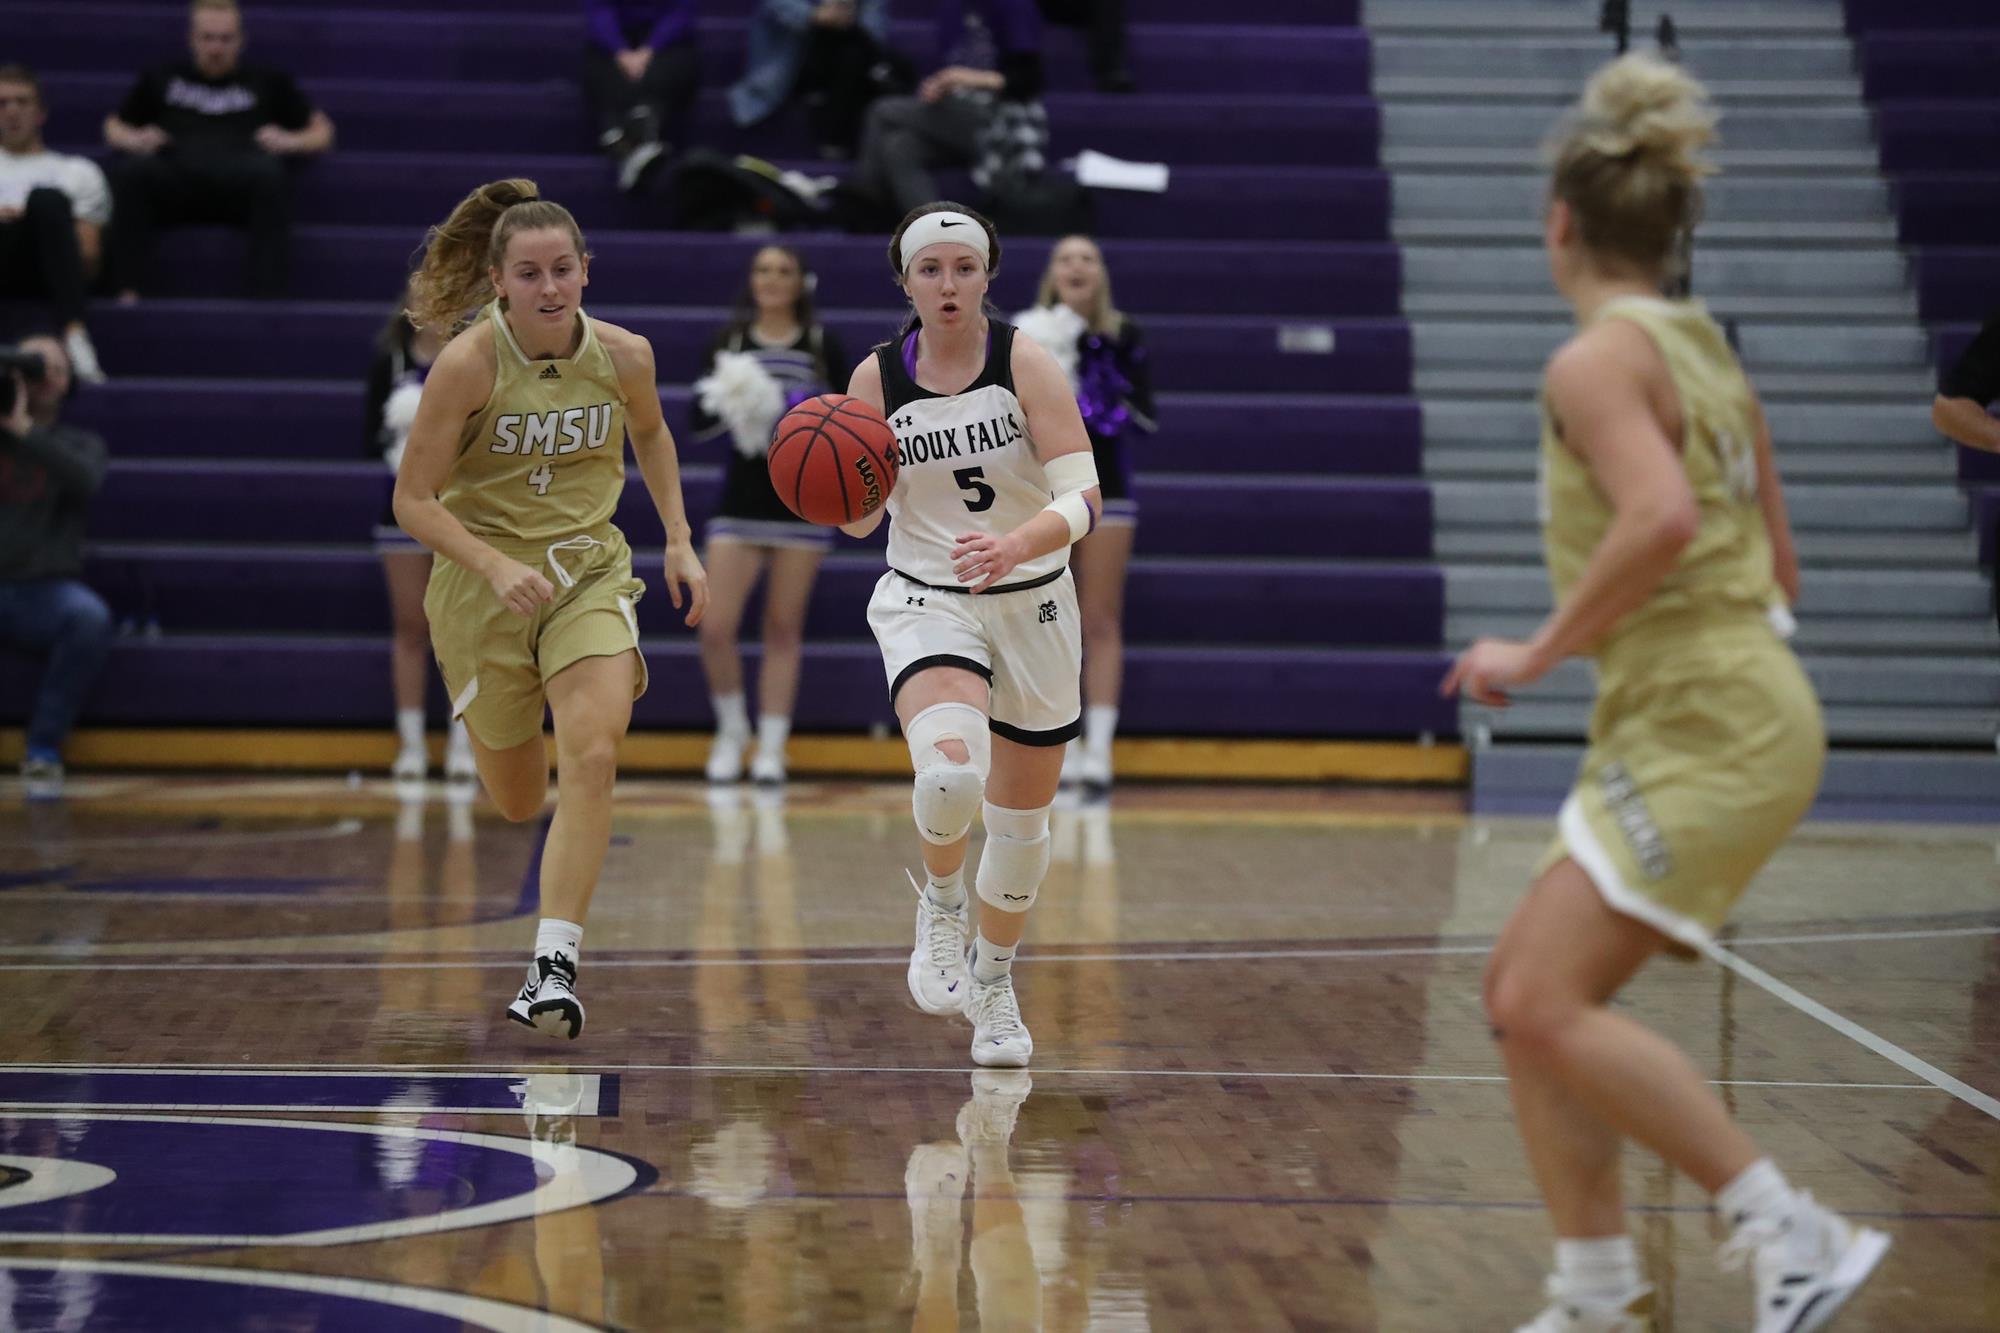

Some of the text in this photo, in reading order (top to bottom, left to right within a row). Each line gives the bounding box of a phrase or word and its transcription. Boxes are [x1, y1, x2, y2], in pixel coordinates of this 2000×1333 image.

[489, 403, 612, 456] SMSU
[897, 413, 1022, 467] SIOUX FALLS
[527, 461, 556, 496] 4
[953, 466, 995, 512] 5
